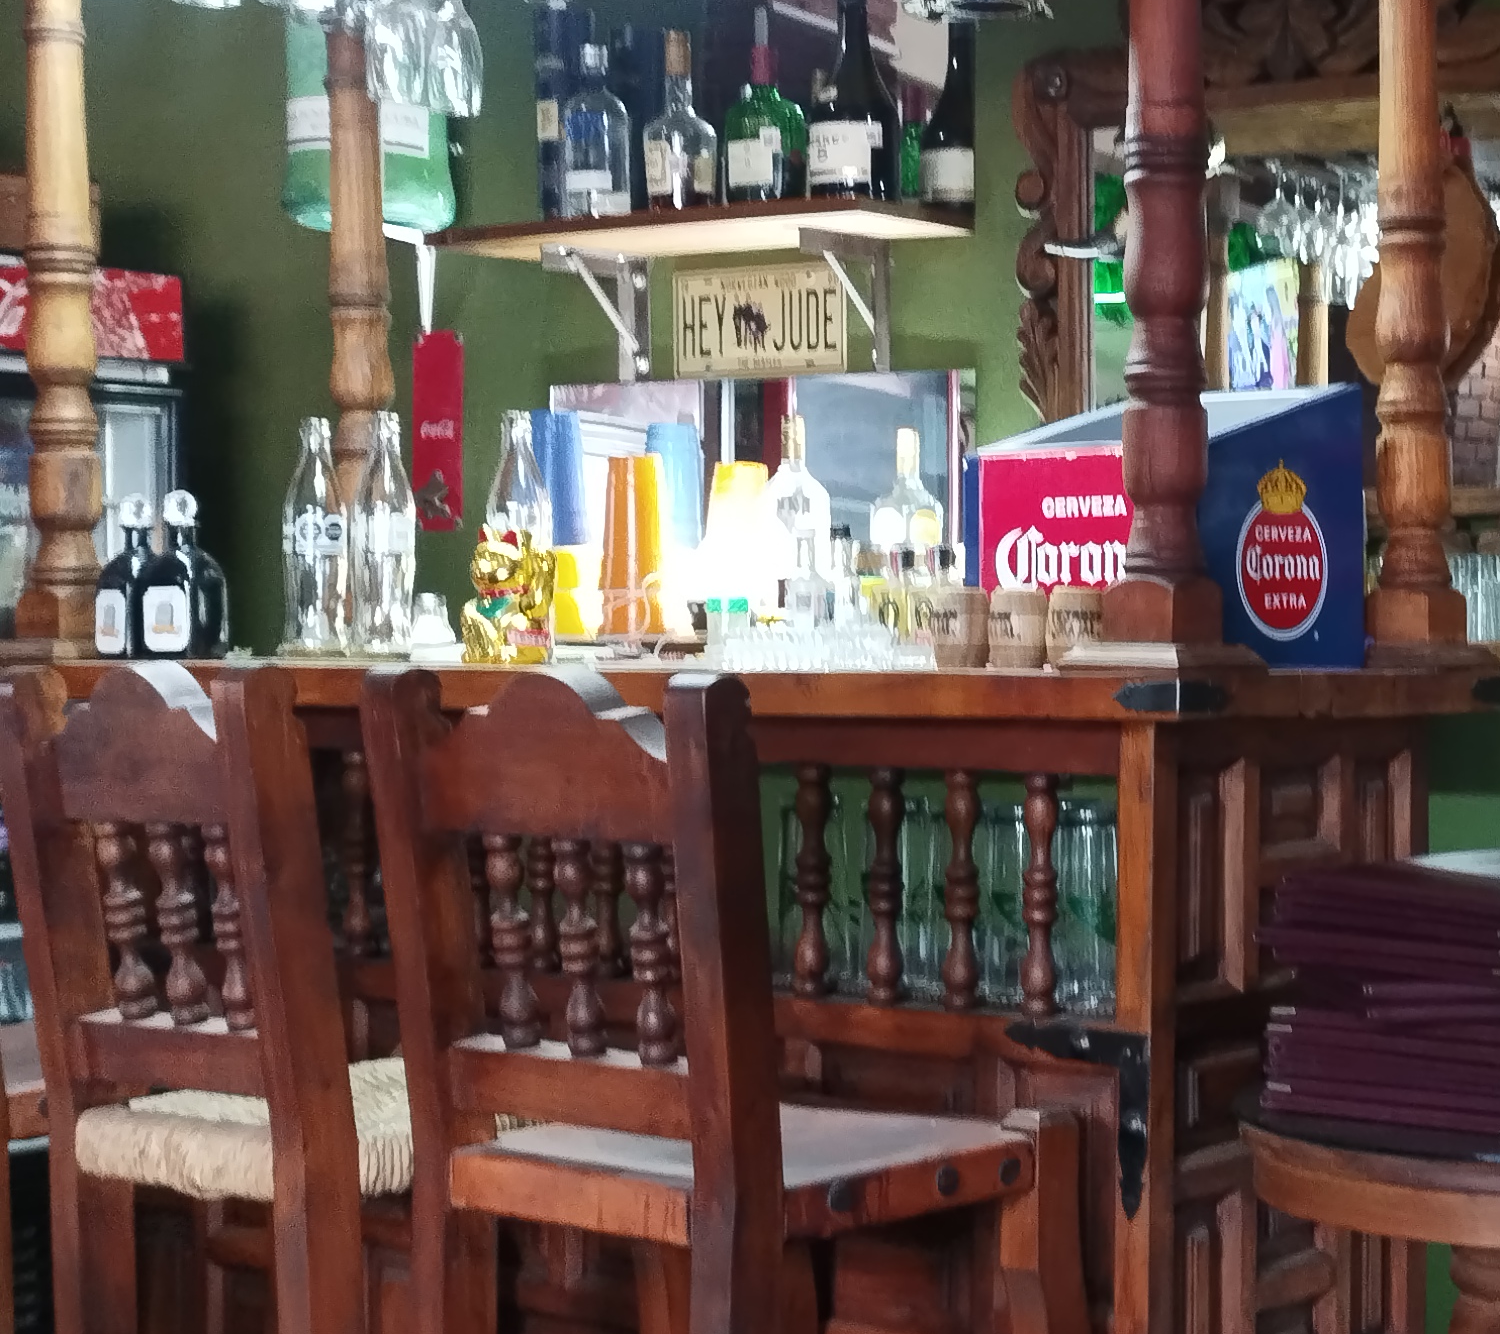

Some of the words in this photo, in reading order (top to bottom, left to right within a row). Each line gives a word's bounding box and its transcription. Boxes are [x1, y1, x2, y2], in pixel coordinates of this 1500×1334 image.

[682, 293, 727, 359] HEY
[772, 286, 837, 352] JUDE
[1041, 494, 1128, 519] CERVEZA
[1255, 524, 1313, 544] CERVEZA
[994, 524, 1128, 590] Coron
[1246, 544, 1322, 585] Corona
[1264, 592, 1308, 612] EXTRA
